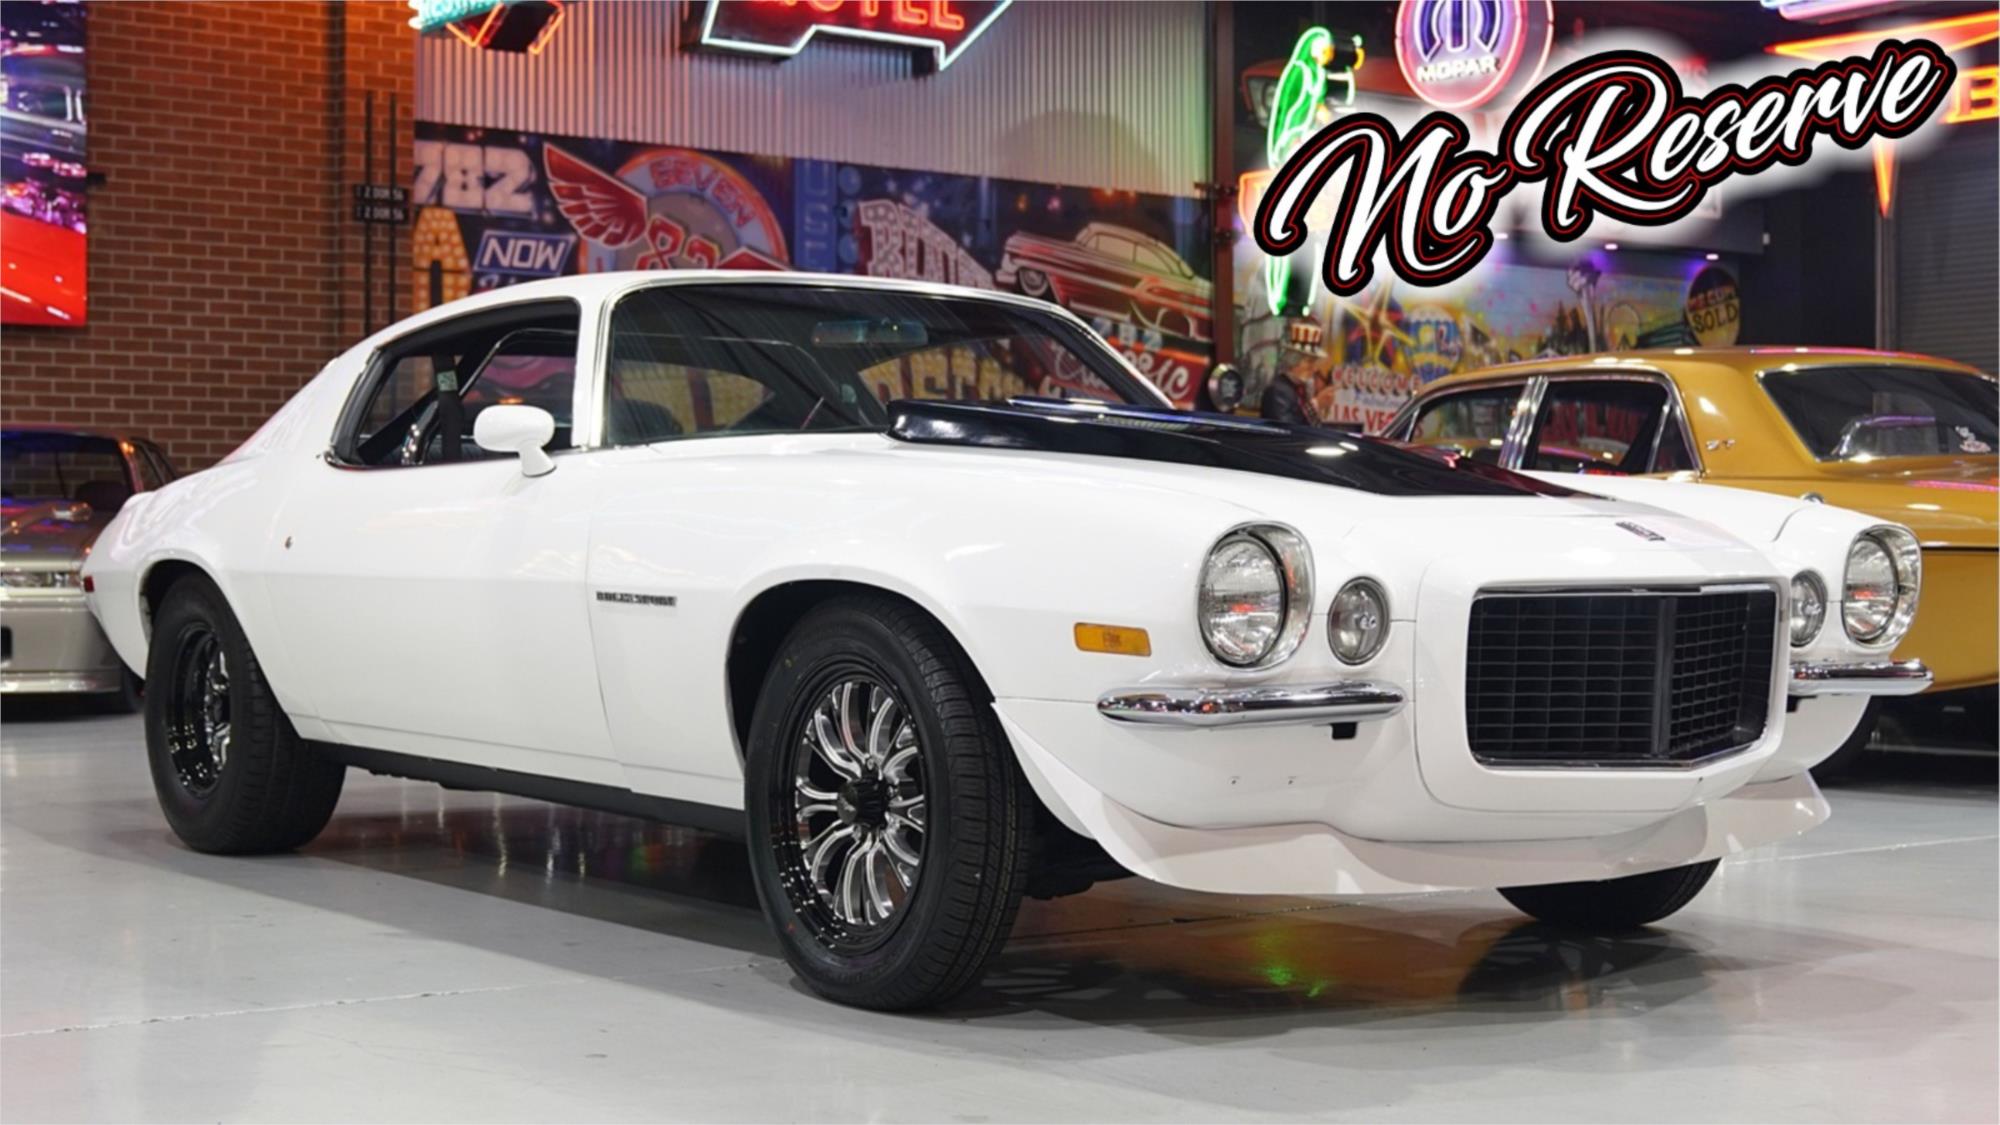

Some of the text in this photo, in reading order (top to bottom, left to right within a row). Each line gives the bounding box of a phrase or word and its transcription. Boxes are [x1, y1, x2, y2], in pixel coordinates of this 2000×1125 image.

[1416, 56, 1500, 81] MOPAR
[414, 139, 536, 214] 782
[482, 238, 565, 271] NOW
[1692, 303, 1738, 333] SOLD
